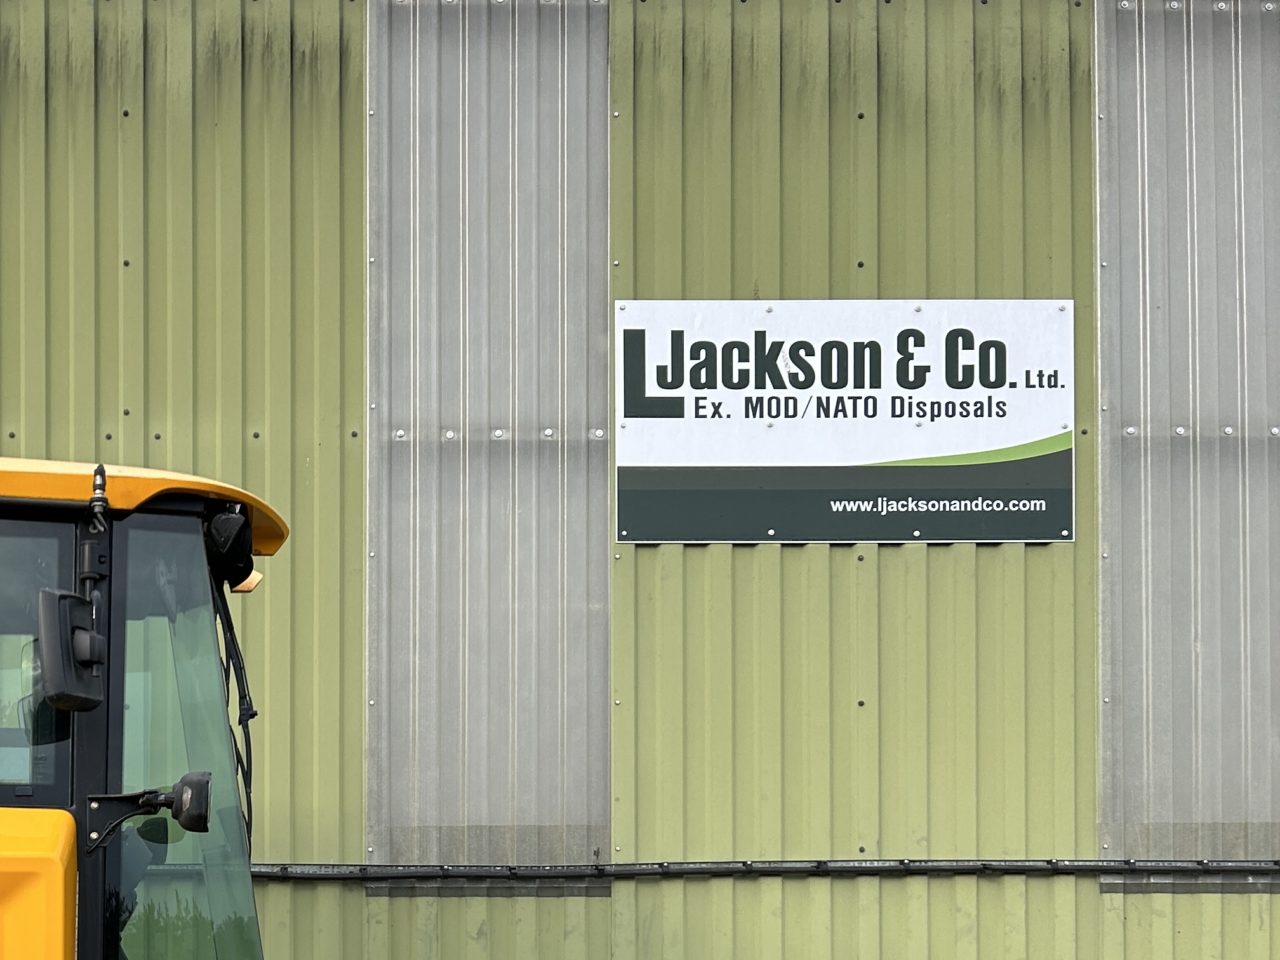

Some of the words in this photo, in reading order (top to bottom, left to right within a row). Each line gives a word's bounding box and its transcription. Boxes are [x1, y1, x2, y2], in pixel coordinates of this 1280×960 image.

[895, 328, 931, 390] &
[944, 328, 1018, 390] Co.
[1025, 369, 1065, 389] Ltd.
[695, 398, 731, 419] Ex.
[744, 395, 878, 419] MOD/NATO
[891, 396, 1007, 422] Disposals
[830, 497, 1046, 515] www.ljacksonandco.com
